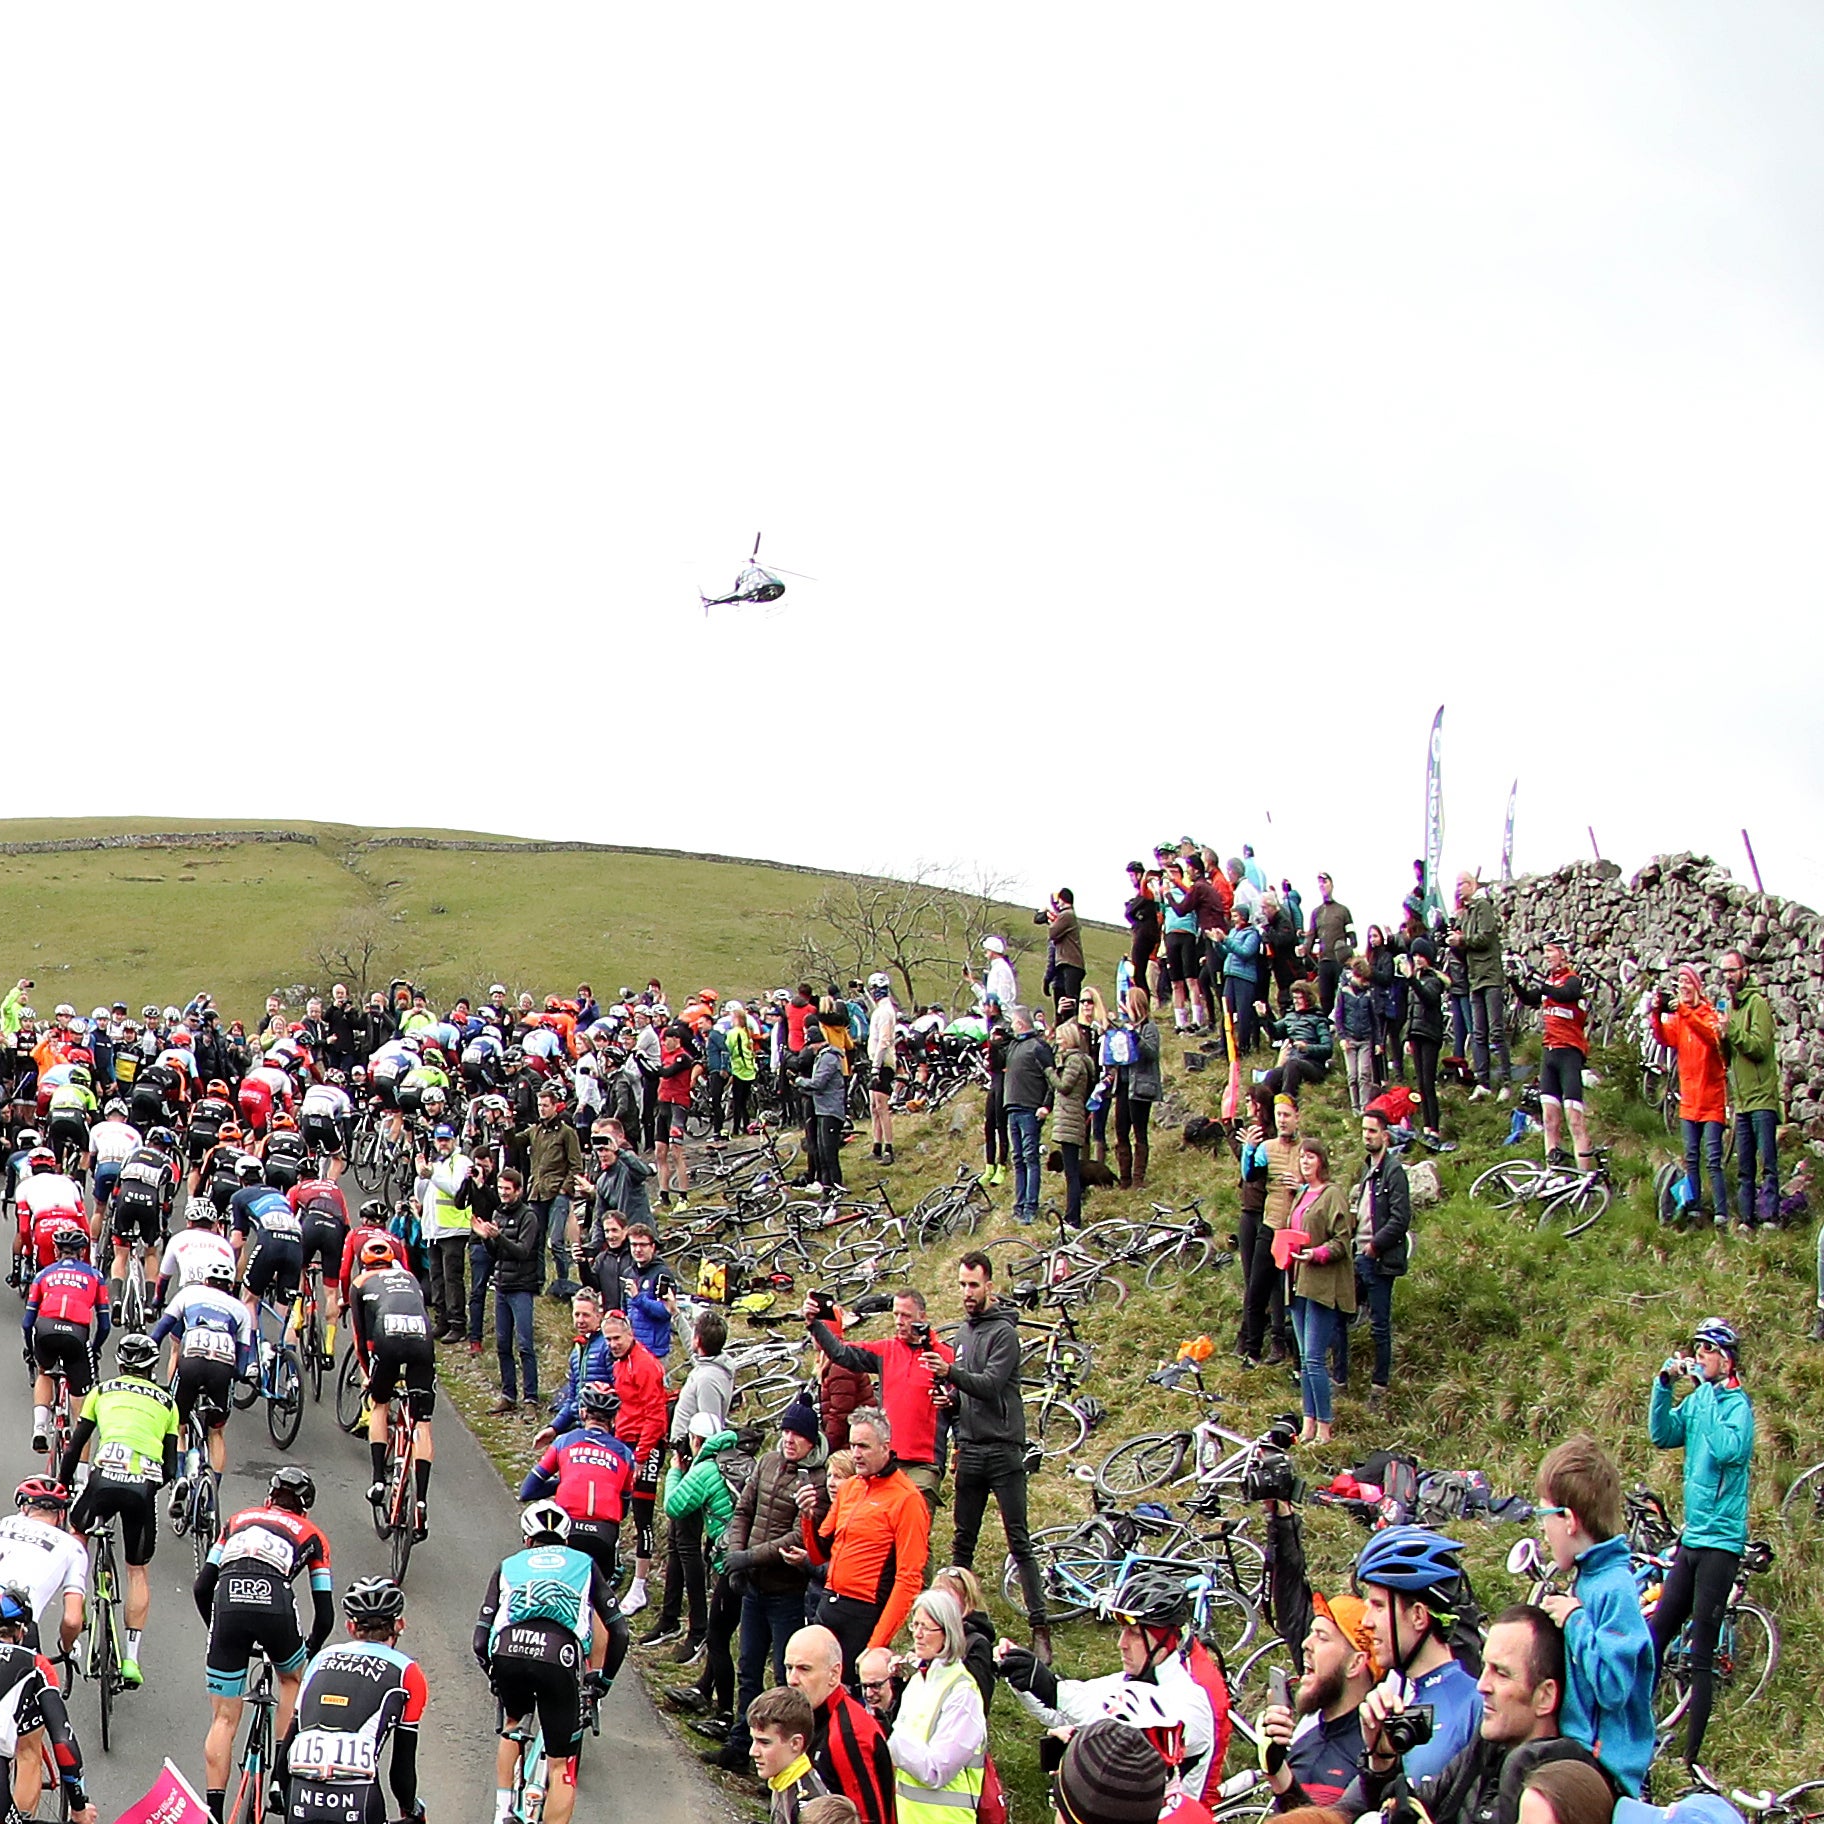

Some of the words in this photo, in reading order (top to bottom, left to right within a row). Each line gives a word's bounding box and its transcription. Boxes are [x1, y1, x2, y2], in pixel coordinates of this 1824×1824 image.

[569, 1446, 618, 1466] WIGGINS
[573, 1457, 586, 1465] LE
[588, 1457, 612, 1470] COL
[262, 1534, 288, 1559] 55
[511, 1629, 547, 1646] VITAL
[507, 1643, 546, 1658] concept
[294, 1736, 324, 1764] 115
[335, 1736, 371, 1769] 115
[300, 1789, 354, 1808] NEON
